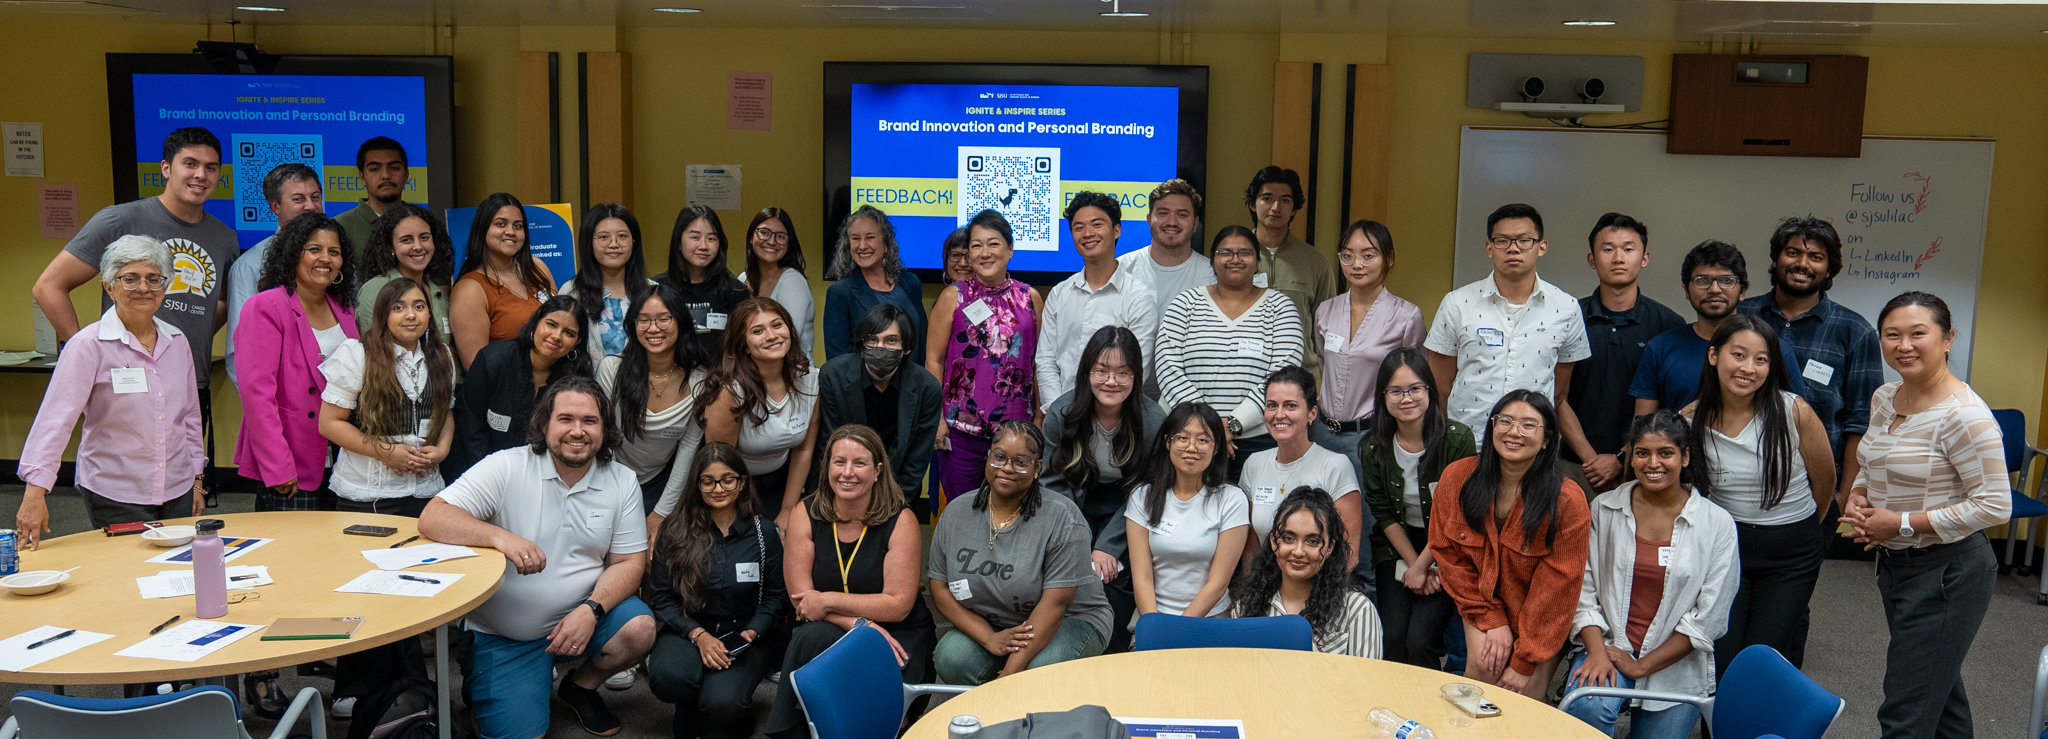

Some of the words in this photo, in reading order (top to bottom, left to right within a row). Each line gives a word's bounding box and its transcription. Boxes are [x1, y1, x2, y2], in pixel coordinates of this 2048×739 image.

[159, 108, 196, 119] Brand
[198, 109, 263, 120] Innovation
[266, 110, 290, 120] and
[292, 110, 346, 120] Personal
[348, 110, 405, 124] Branding
[966, 106, 994, 115] IGNITE
[1004, 108, 1036, 116] INSPIRE
[878, 119, 920, 132] Brand
[922, 120, 995, 132] Innovation
[998, 121, 1025, 133] and
[1028, 122, 1089, 134] Personal
[1092, 122, 1154, 138] Branding
[856, 188, 952, 204] FEEDBACK!
[1850, 183, 1894, 203] Follow
[1901, 192, 1915, 204] us
[1848, 234, 1862, 244] on
[1864, 249, 1914, 263] LinkedIn
[1864, 266, 1920, 284] Instagram
[164, 299, 188, 312] SJSU
[956, 548, 1014, 580] Love
[1013, 596, 1034, 613] is
